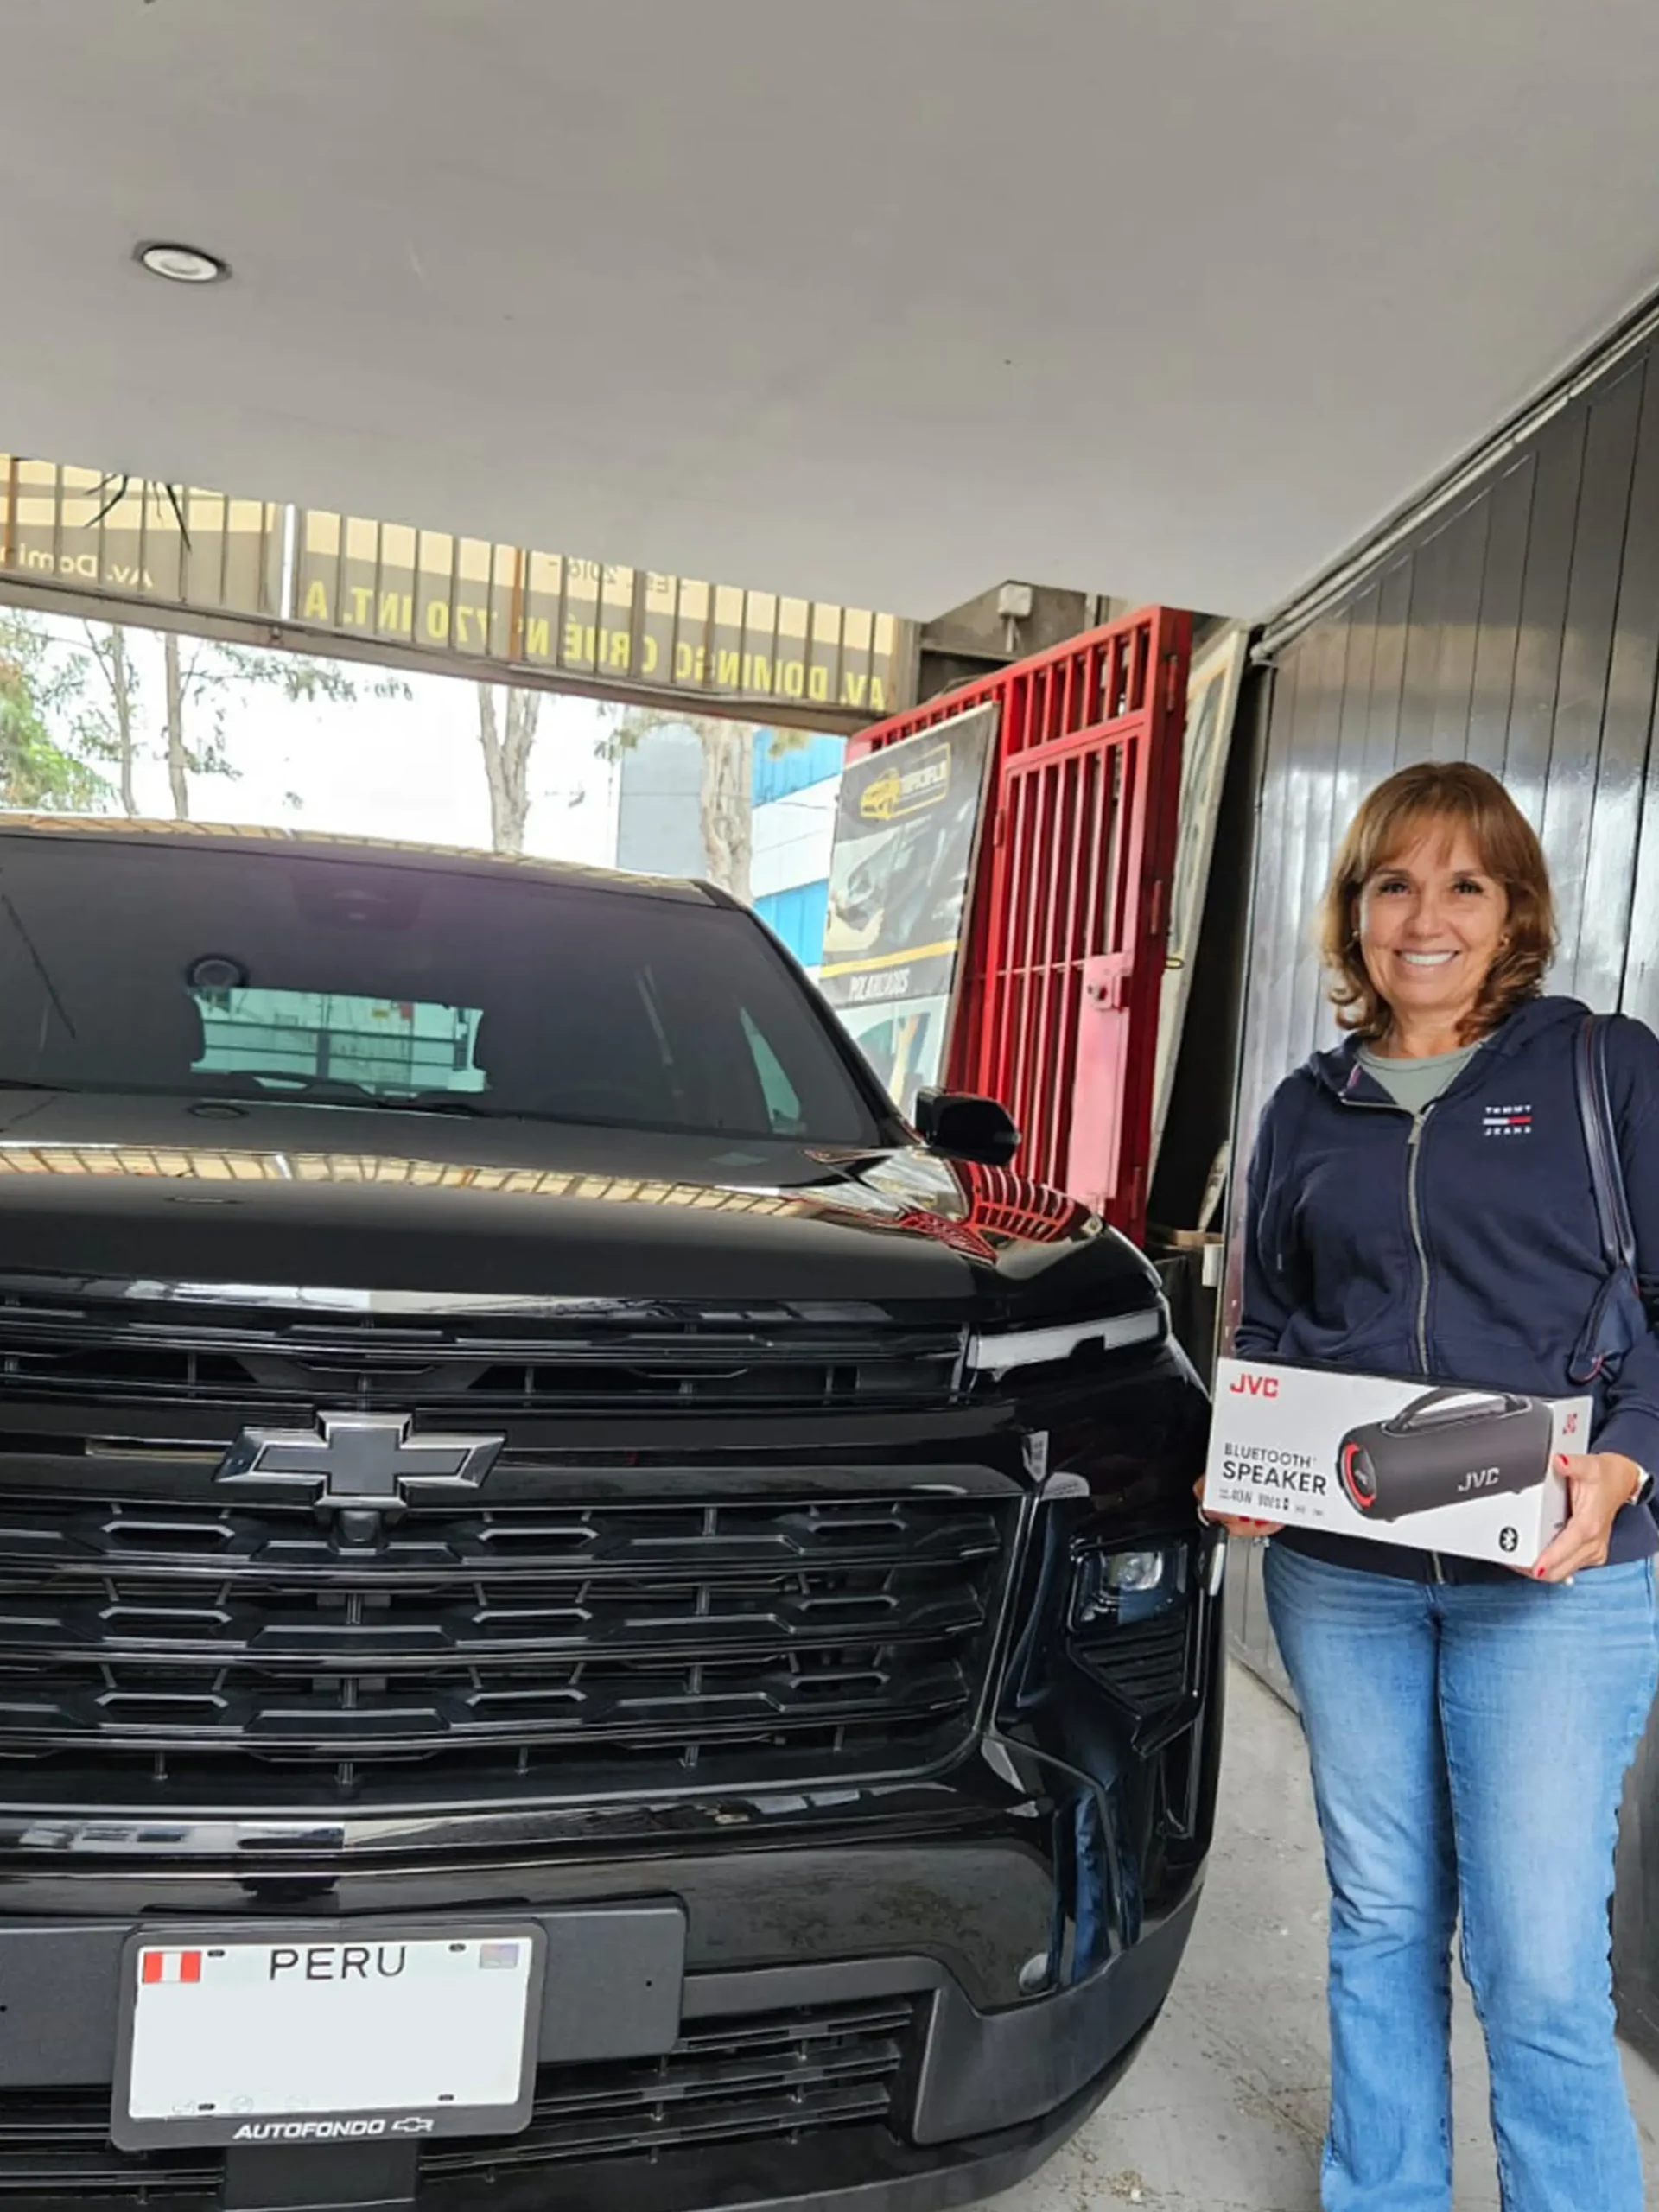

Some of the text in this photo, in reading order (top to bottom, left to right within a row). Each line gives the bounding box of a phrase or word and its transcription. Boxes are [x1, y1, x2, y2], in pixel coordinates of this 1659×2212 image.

[1230, 1374, 1279, 1398] JVC
[1224, 1443, 1312, 1468] BLUETOOTH
[1223, 1461, 1326, 1496] SPEAKER
[1457, 1467, 1500, 1493] JVC
[270, 1946, 407, 1980] PERU
[232, 2118, 386, 2140] AUTOFONDO
